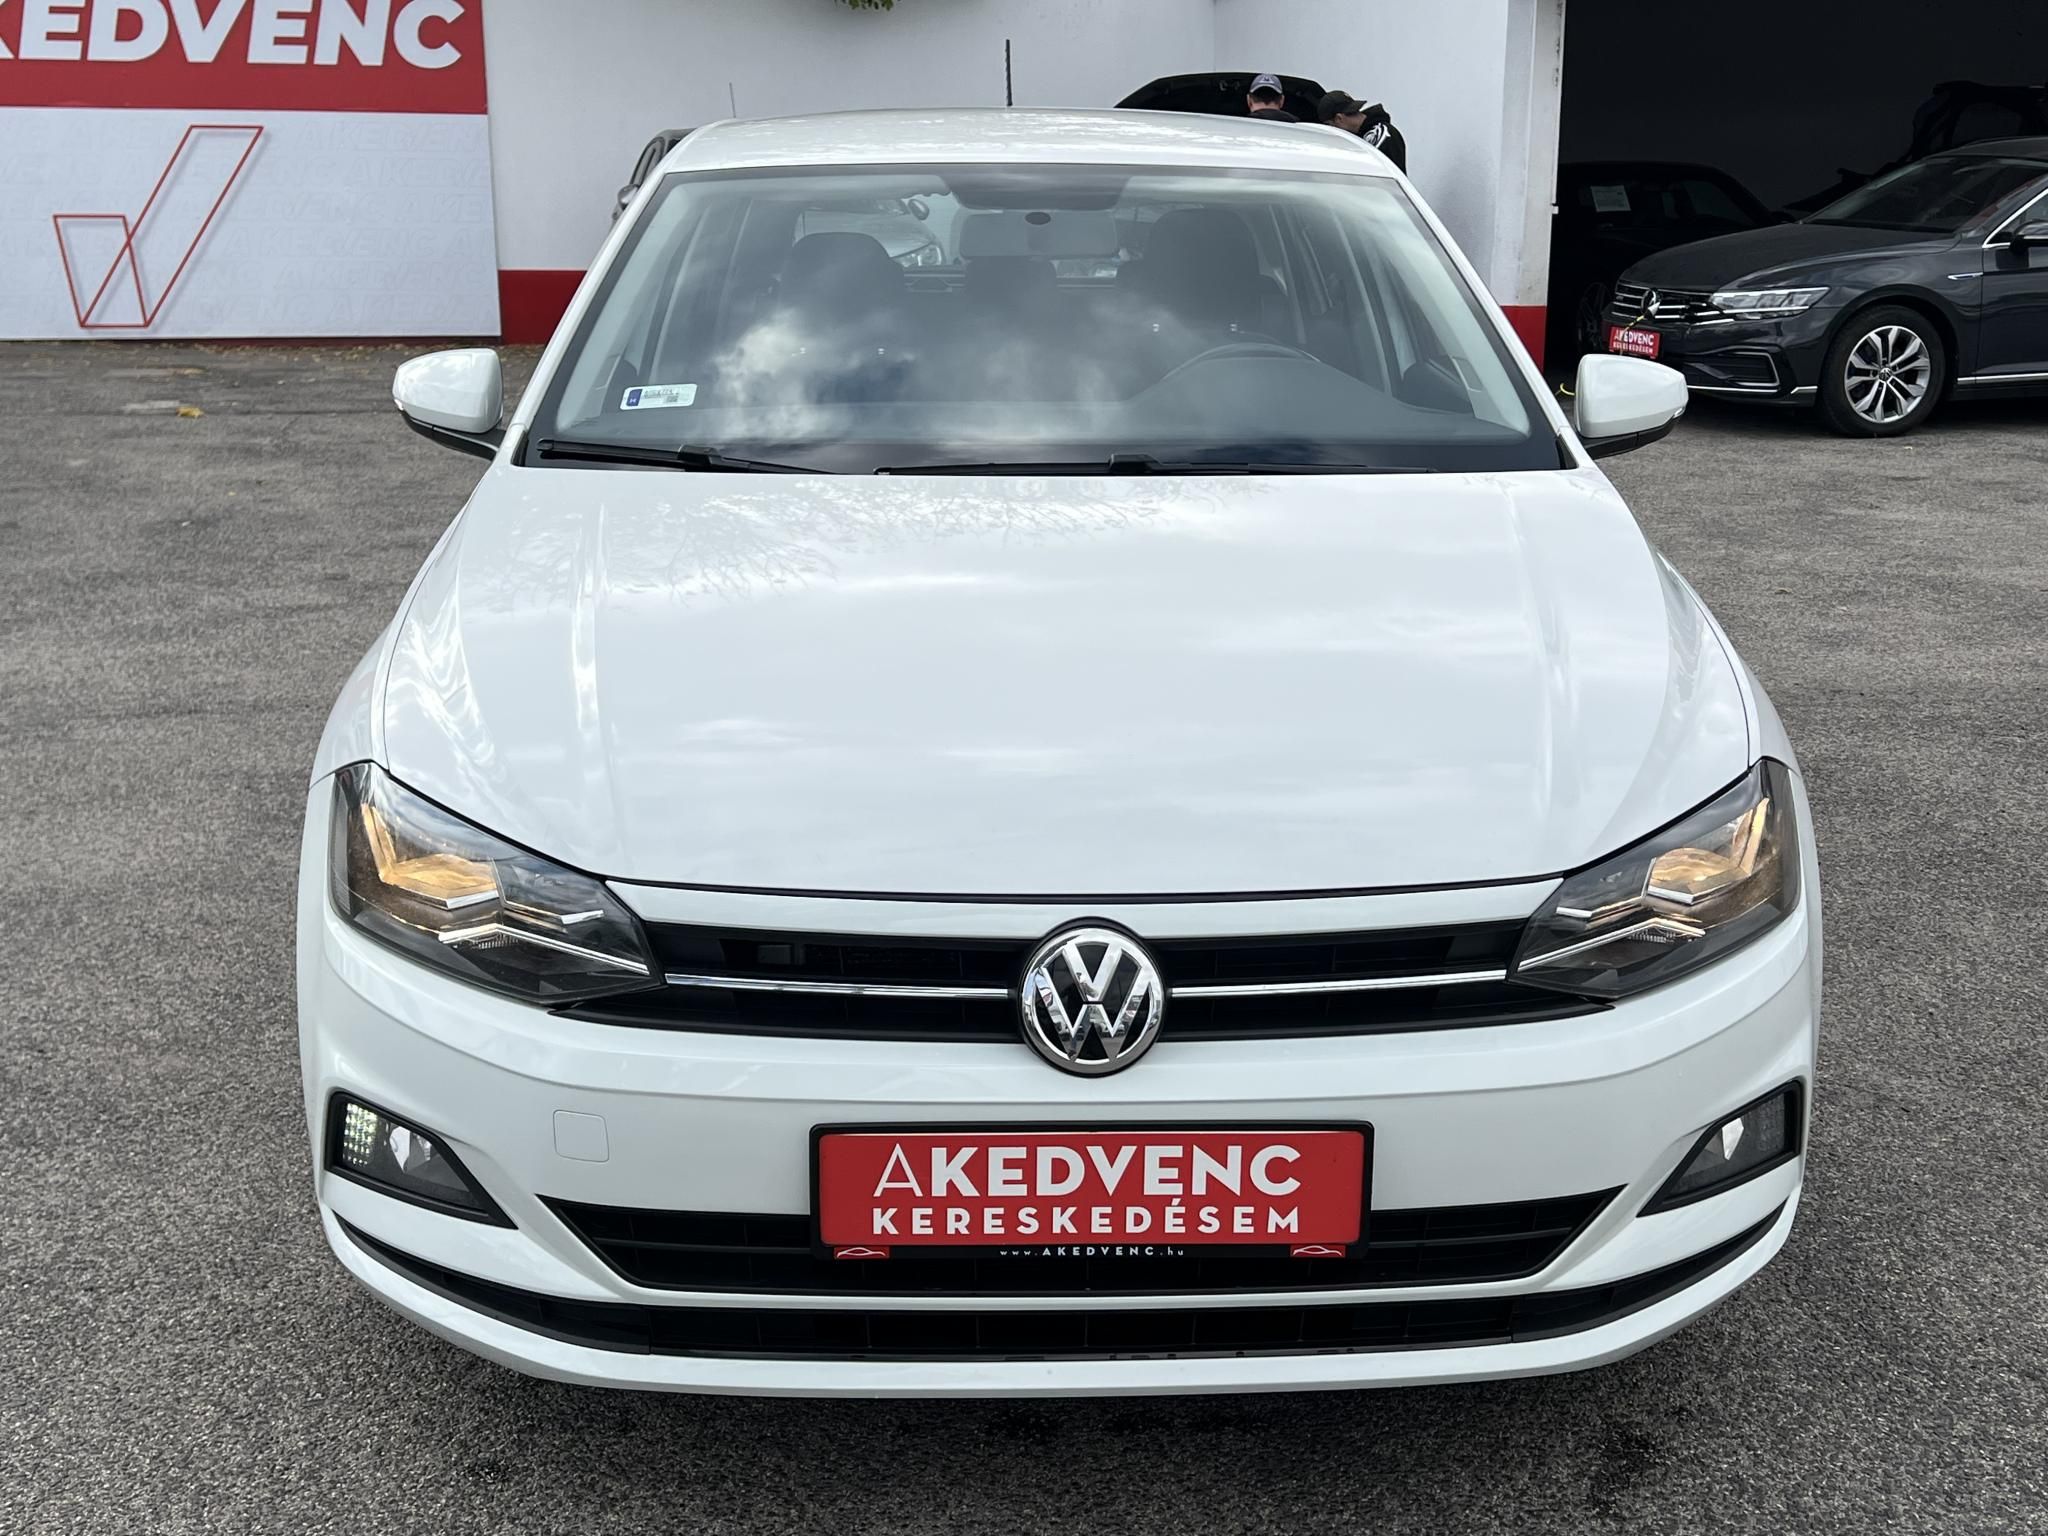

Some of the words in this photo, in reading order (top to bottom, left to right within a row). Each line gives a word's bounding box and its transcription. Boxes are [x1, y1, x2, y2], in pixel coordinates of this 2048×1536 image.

[0, 0, 466, 69] EDVENC
[872, 1143, 1301, 1197] AKEDVENC
[872, 1198, 1299, 1235] KERESKEDÉSEM
[1000, 1246, 1184, 1256] www.AKEDVENC.hu
